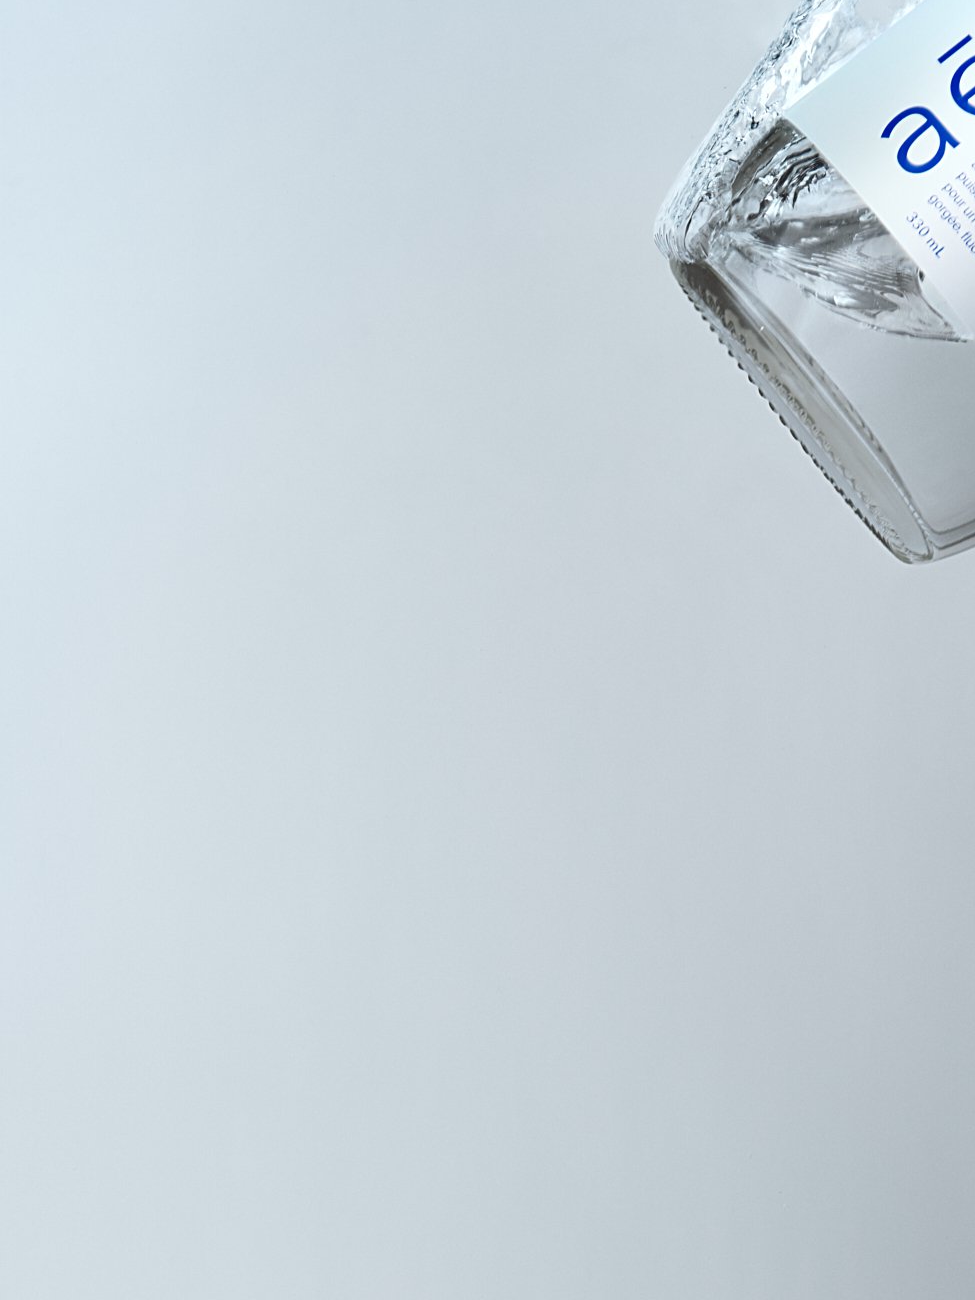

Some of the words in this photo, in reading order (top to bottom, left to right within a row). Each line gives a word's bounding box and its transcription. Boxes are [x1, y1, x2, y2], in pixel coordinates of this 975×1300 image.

[940, 182, 966, 207] pour
[906, 211, 930, 237] 330
[926, 237, 945, 259] mL
